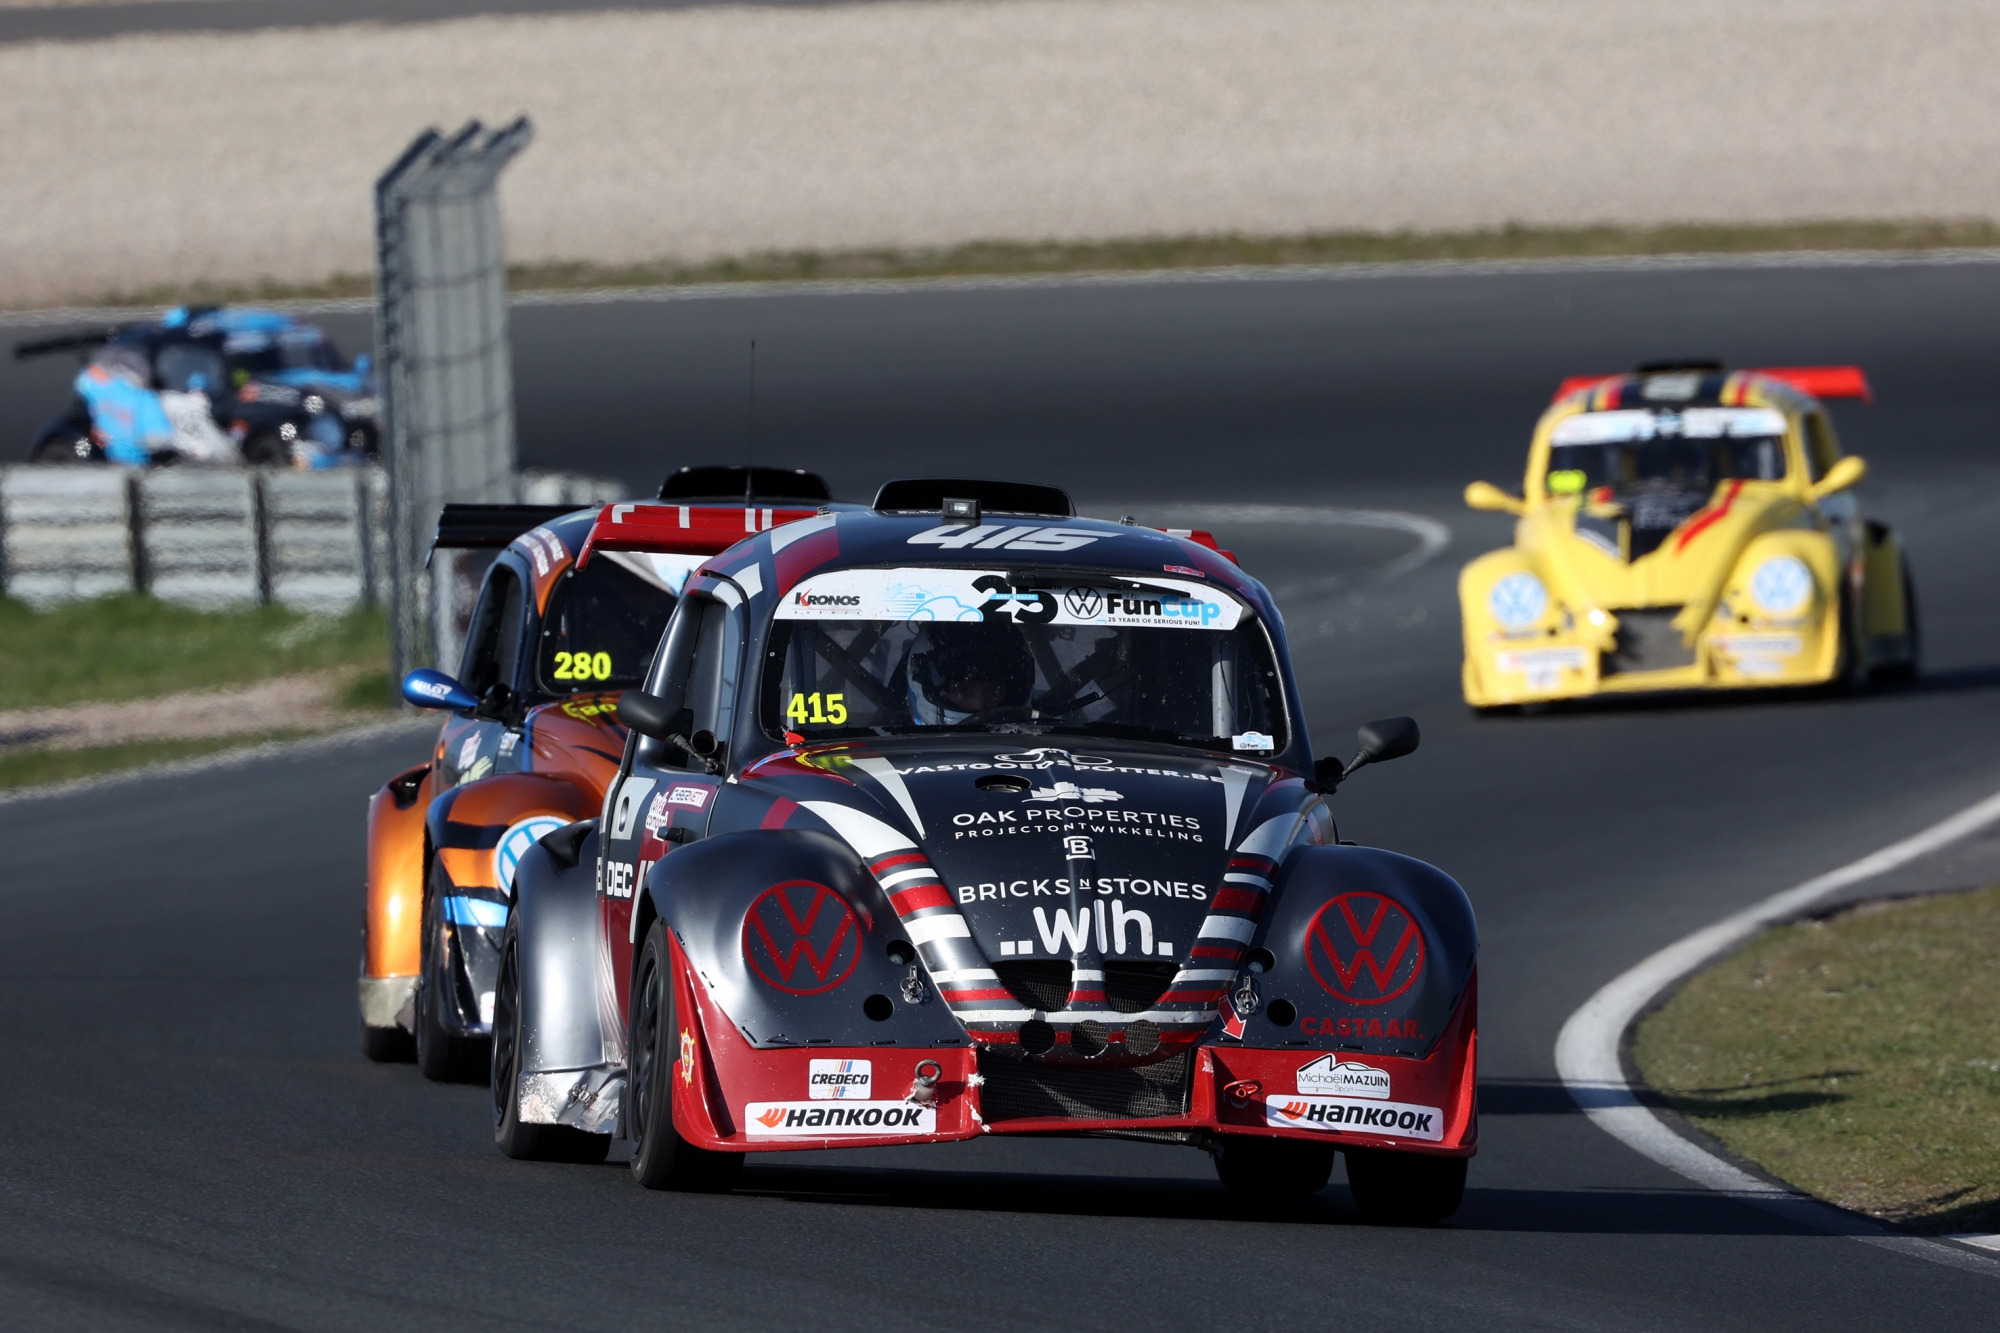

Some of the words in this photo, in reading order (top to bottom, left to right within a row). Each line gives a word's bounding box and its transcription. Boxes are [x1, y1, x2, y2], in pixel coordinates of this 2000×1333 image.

[906, 524, 1126, 552] 415
[795, 588, 860, 607] KRONOS
[971, 574, 1059, 625] 25
[1107, 593, 1220, 626] FunCup
[553, 651, 612, 681] 280
[786, 692, 848, 724] 415
[952, 809, 1018, 827] OAK
[1026, 806, 1201, 830] PROPERTIES
[955, 822, 1204, 843] PROJECTONTWIKKELING
[958, 878, 1071, 904] BRICKS
[1079, 878, 1092, 890] N
[1097, 878, 1208, 900] STONES
[811, 1073, 869, 1085] CREDECO
